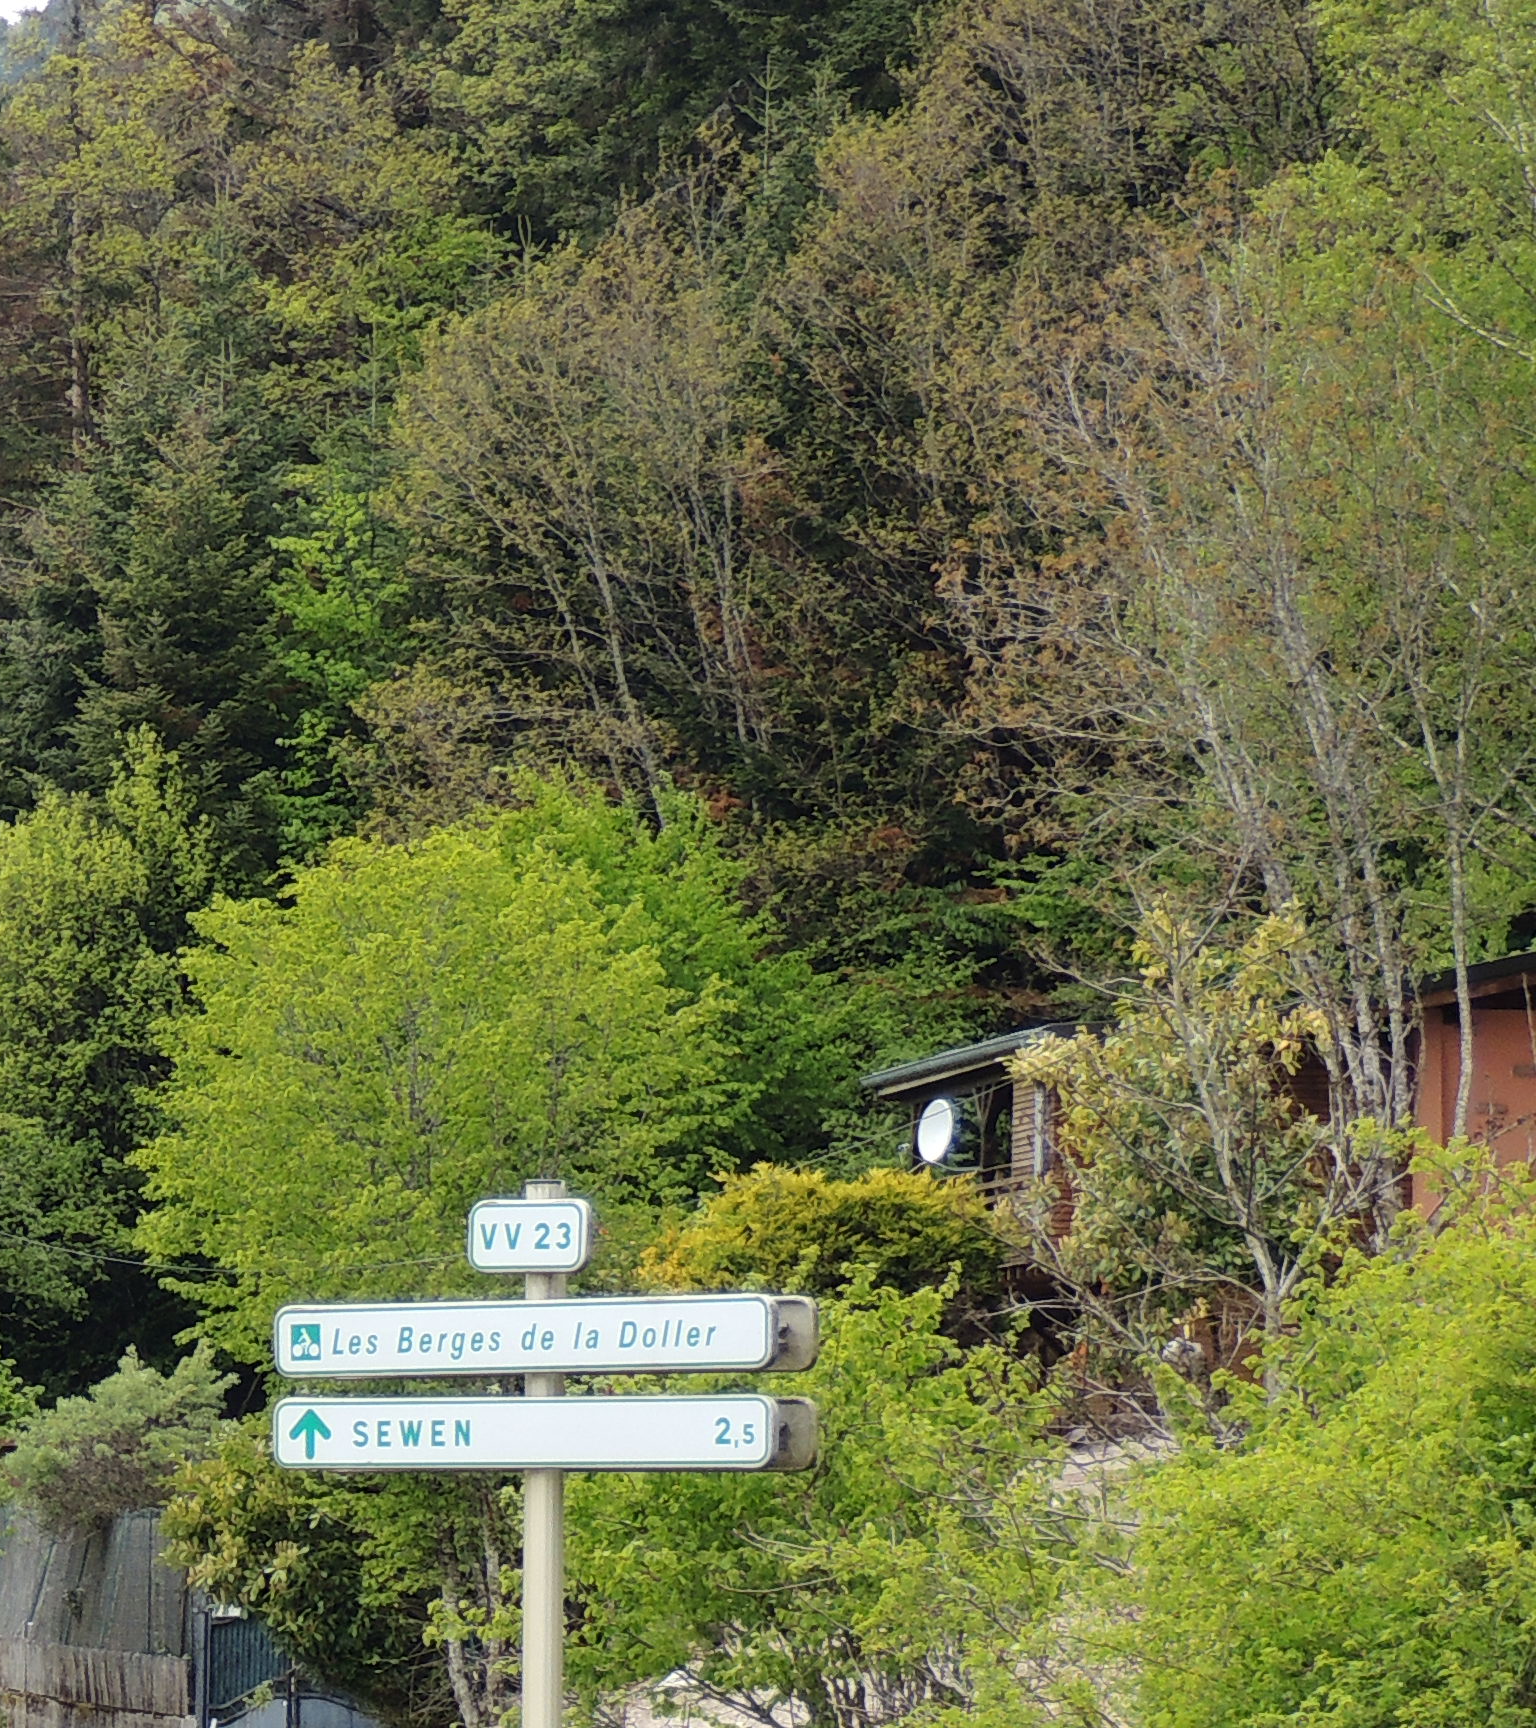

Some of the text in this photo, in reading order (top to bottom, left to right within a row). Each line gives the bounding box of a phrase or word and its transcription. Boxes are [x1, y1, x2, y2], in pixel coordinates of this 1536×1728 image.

[332, 1321, 717, 1360] Les Berges de la Doller
[352, 1418, 755, 1449] SEWEN 2,5
